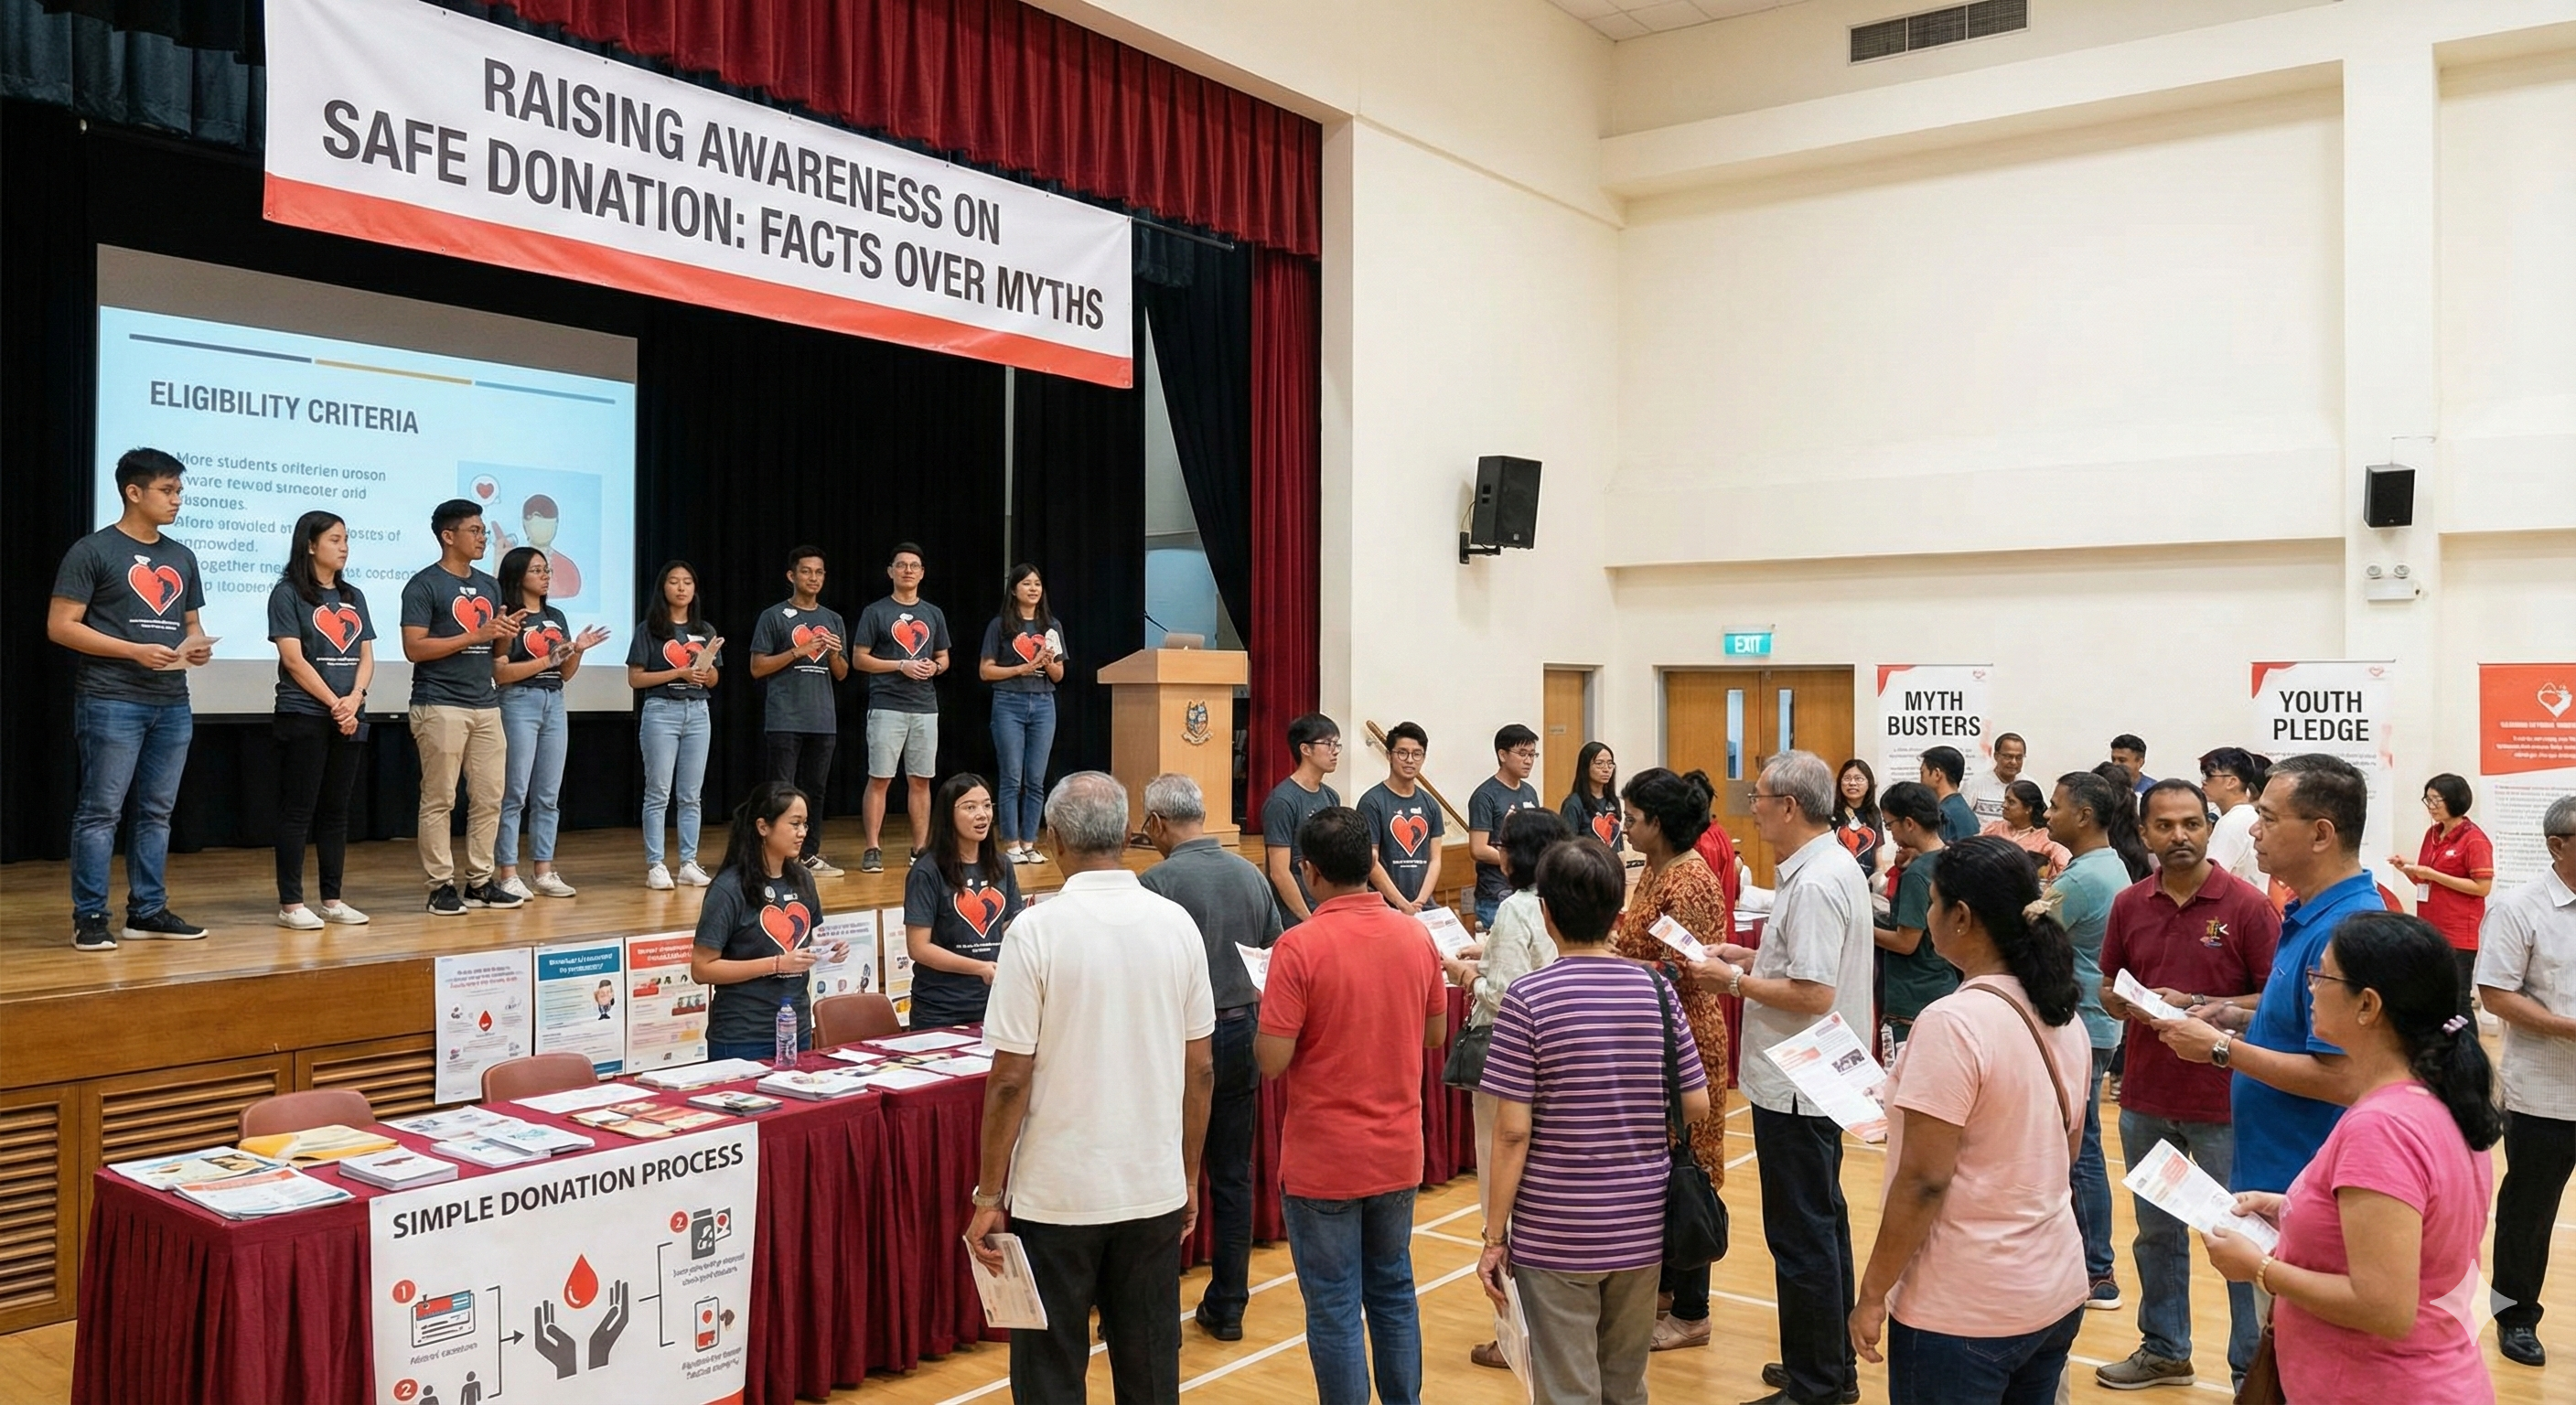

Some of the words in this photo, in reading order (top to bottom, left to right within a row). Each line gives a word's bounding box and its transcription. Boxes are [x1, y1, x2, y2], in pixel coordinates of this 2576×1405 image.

[484, 57, 684, 162] RAISING
[697, 121, 942, 229] AWARENESS
[954, 193, 1000, 245] ON
[322, 99, 467, 187] SAFE
[488, 137, 745, 249] DONATION:
[760, 207, 882, 279] FACTS
[895, 241, 984, 304] OVER
[997, 265, 1104, 330] MYTHS
[150, 381, 300, 420] ELIGIBILITY
[307, 399, 419, 434] CRITERIA
[176, 451, 213, 467] More
[218, 456, 277, 472] students
[183, 476, 222, 488] ware
[197, 560, 255, 574] ogether
[1734, 635, 1763, 653] EXIT
[1905, 691, 1962, 711] MYTH
[2279, 691, 2362, 713] YOUTH
[1888, 716, 1980, 736] BUSTERS
[2273, 719, 2369, 742] PLEDGE
[392, 1196, 494, 1239] SIMPLE
[501, 1167, 635, 1217] DONATION
[641, 1142, 744, 1185] PROCESS
[675, 1217, 684, 1229] 2
[401, 1383, 412, 1397] 2
